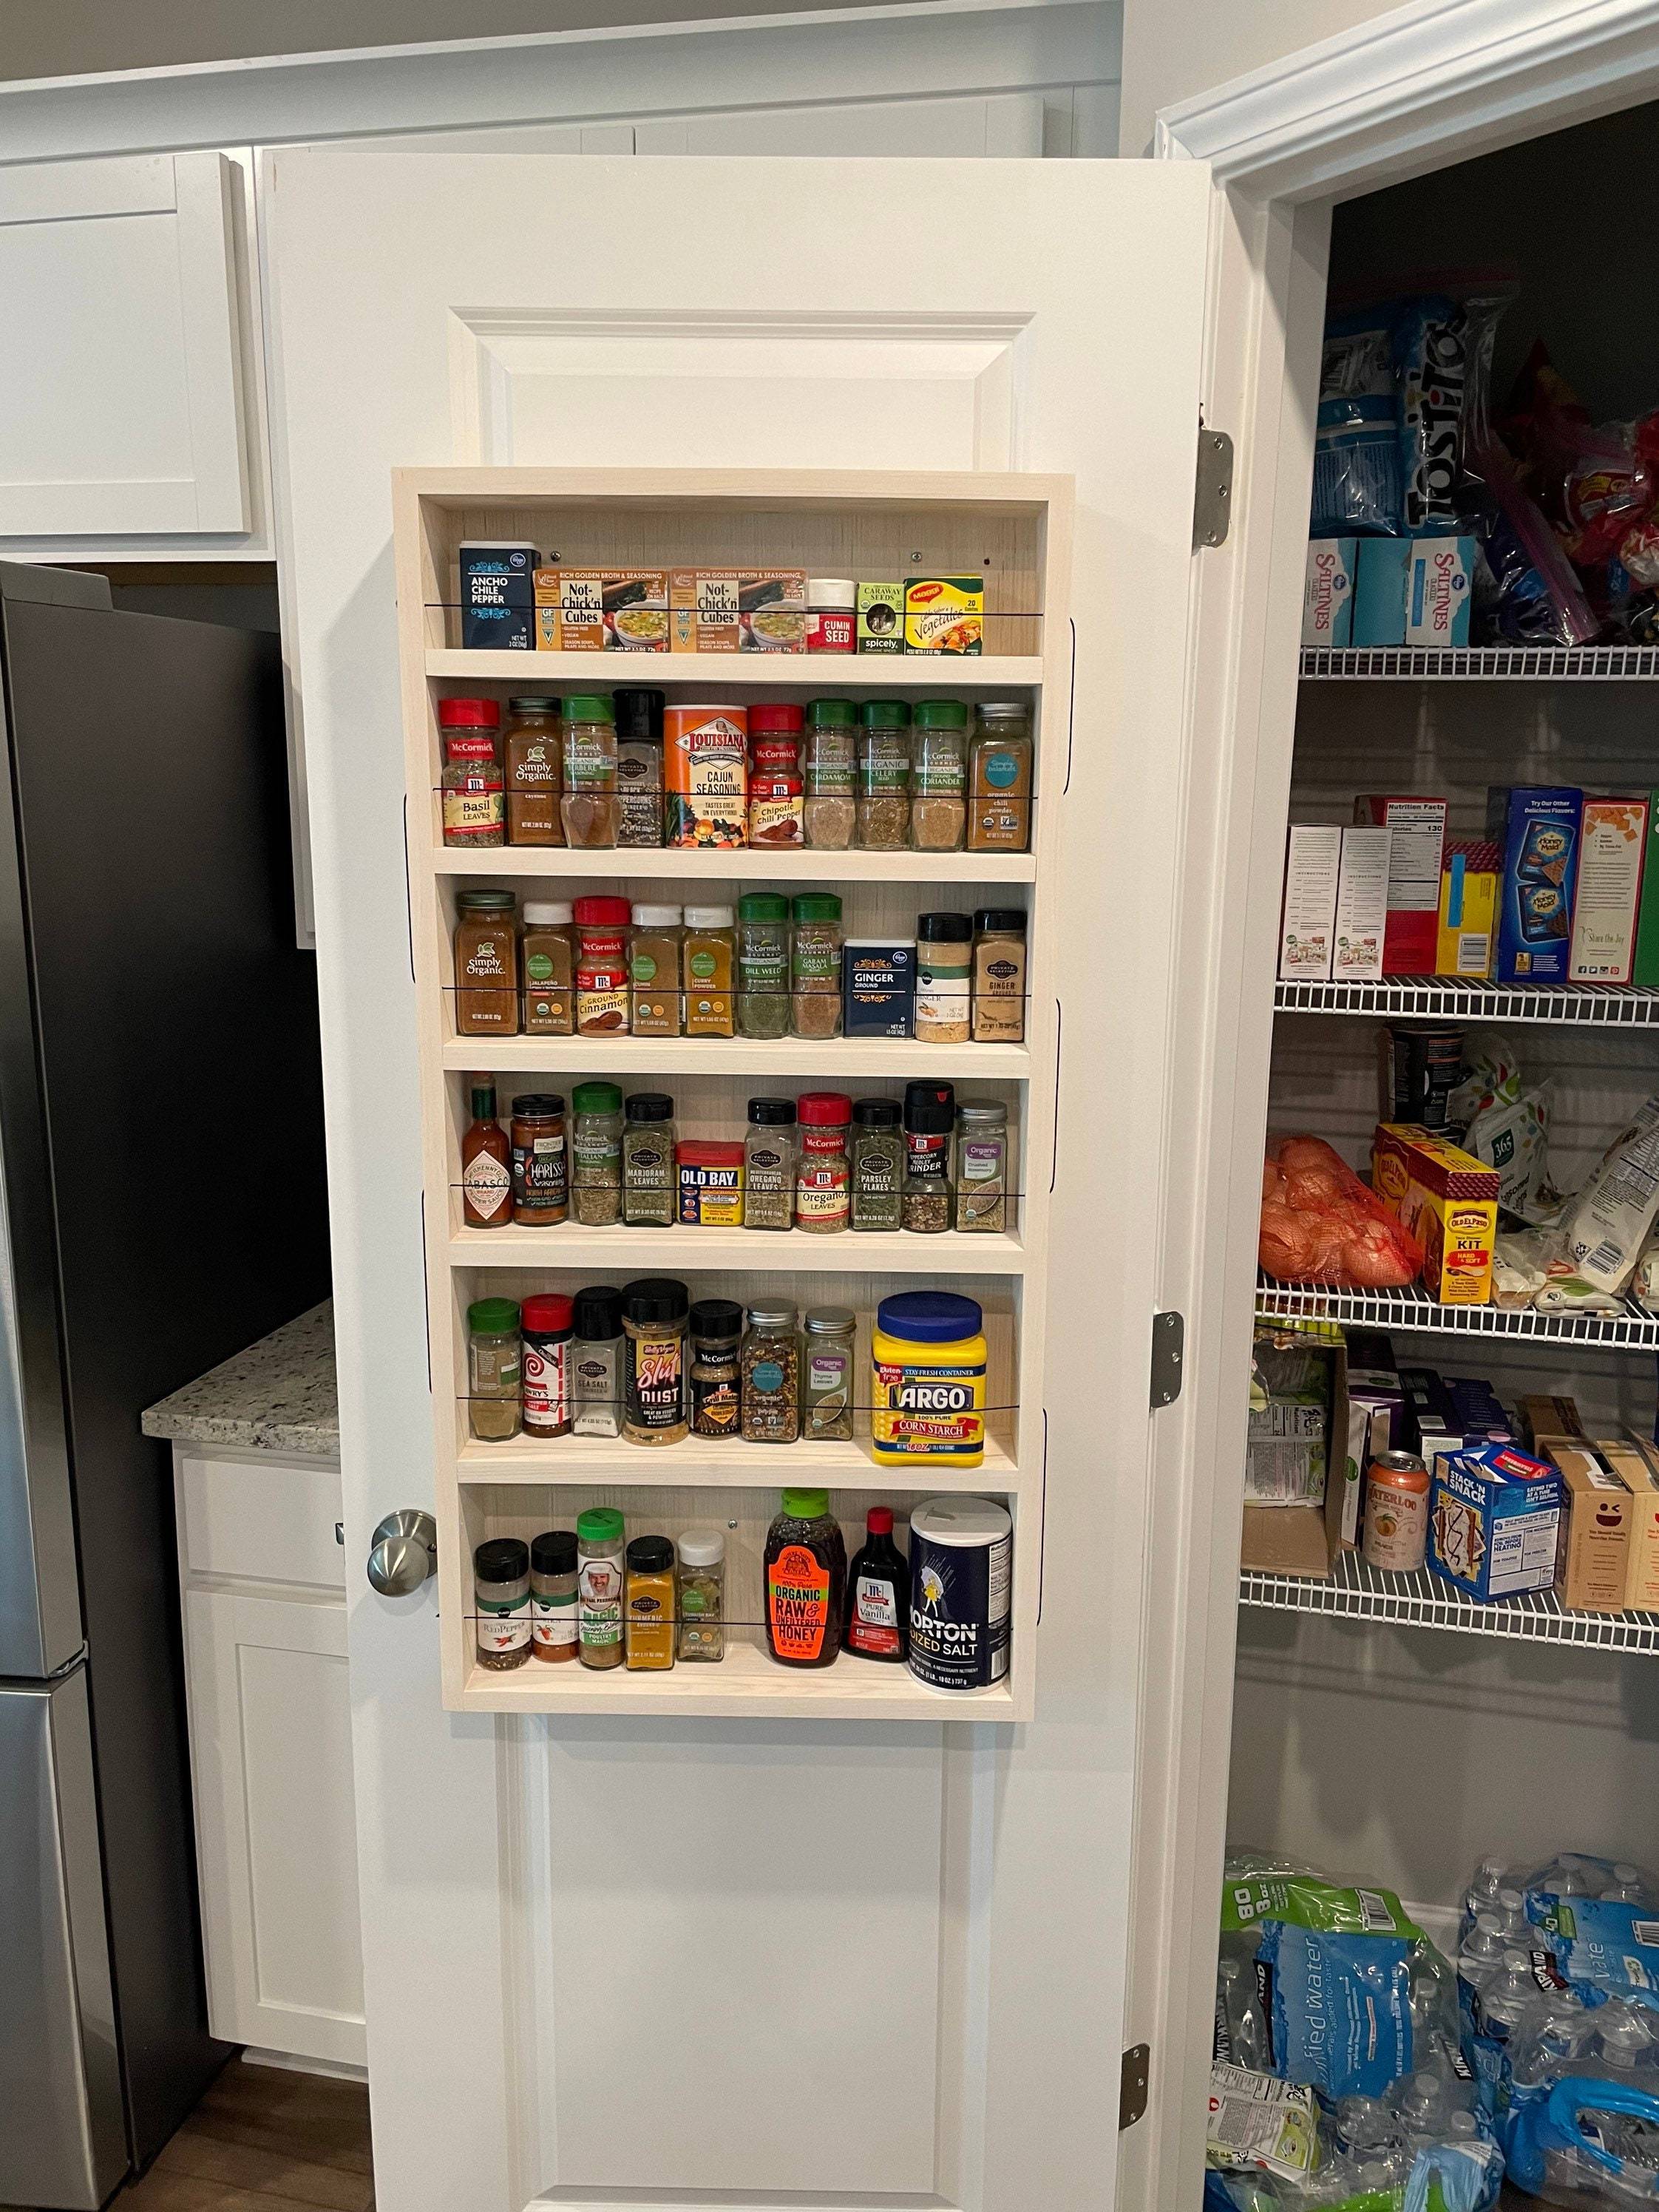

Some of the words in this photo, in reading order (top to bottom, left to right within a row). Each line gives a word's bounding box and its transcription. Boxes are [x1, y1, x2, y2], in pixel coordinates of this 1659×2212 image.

[472, 577, 508, 586] ANCHO
[472, 586, 498, 594] CHILE
[569, 583, 593, 596] Not-
[705, 583, 729, 596] Not-
[1315, 552, 1336, 631] SALTINES
[1434, 552, 1454, 631] SALTINES
[472, 595, 504, 603] PEPPER
[561, 597, 601, 608] Chick'n
[697, 597, 736, 610] Chick'n
[566, 610, 598, 622] Cubes
[701, 611, 734, 624] Cubes
[824, 621, 850, 631] CUMIN
[825, 631, 849, 642] SEED
[866, 639, 898, 649] spicely
[452, 742, 493, 752] McCormick
[689, 733, 744, 752] LOUISIANA
[757, 750, 796, 758] McCormick
[518, 762, 551, 774] Simply
[707, 772, 733, 782] CAJUN
[696, 784, 741, 794] SEASONING
[463, 801, 489, 812] Basil
[761, 803, 794, 816] Chipotle
[463, 812, 490, 821] LEAVES
[776, 810, 801, 821] Pepper
[1538, 837, 1564, 847] Honey
[1540, 843, 1559, 851] Maid
[1532, 893, 1556, 905] Honey
[1537, 900, 1555, 909] Maid
[583, 942, 621, 951] McCormick
[745, 943, 781, 953] McCormick
[797, 941, 834, 951] McCormick
[468, 957, 501, 970] Simply
[855, 973, 895, 983] GINGER
[989, 982, 1015, 990] GINGER
[588, 994, 619, 1005] GROUND
[580, 998, 628, 1015] Cinnamon
[806, 1137, 844, 1148] McCormick
[1495, 1138, 1512, 1158] 365
[971, 1147, 998, 1156] Organic
[627, 1169, 665, 1178] MARJORAM
[681, 1170, 706, 1186] OLD
[710, 1170, 734, 1186] BAY
[861, 1175, 892, 1183] PARSLEY
[634, 1177, 659, 1185] LEAVES
[750, 1175, 781, 1184] OREGANO
[863, 1183, 889, 1191] FLAKES
[803, 1192, 844, 1204] Oregano
[810, 1202, 836, 1210] LEAVES
[1451, 1219, 1463, 1227] OLD
[1457, 1241, 1482, 1249] KIT
[898, 1388, 966, 1410] ARGO
[899, 1420, 926, 1432] CORN
[928, 1425, 963, 1436] STARCH
[1449, 1470, 1473, 1488] STACK
[1473, 1482, 1486, 1493] 'N
[1449, 1478, 1486, 1505] SNACK
[1493, 1542, 1521, 1553] HEATING
[776, 1585, 821, 1601] ORGANIC
[776, 1594, 807, 1618] RAW
[807, 1604, 821, 1617] &
[866, 1603, 884, 1611] PURE
[860, 1607, 890, 1621] Vanilla
[776, 1616, 821, 1626] UNFILTERED
[910, 1606, 977, 1642] ORTON
[778, 1626, 817, 1641] HONEY
[910, 1629, 940, 1652] DIZED
[943, 1643, 978, 1656] SALT
[1233, 1887, 1255, 1920] 80
[1255, 1897, 1272, 1914] 8
[1304, 1936, 1323, 2009] water
